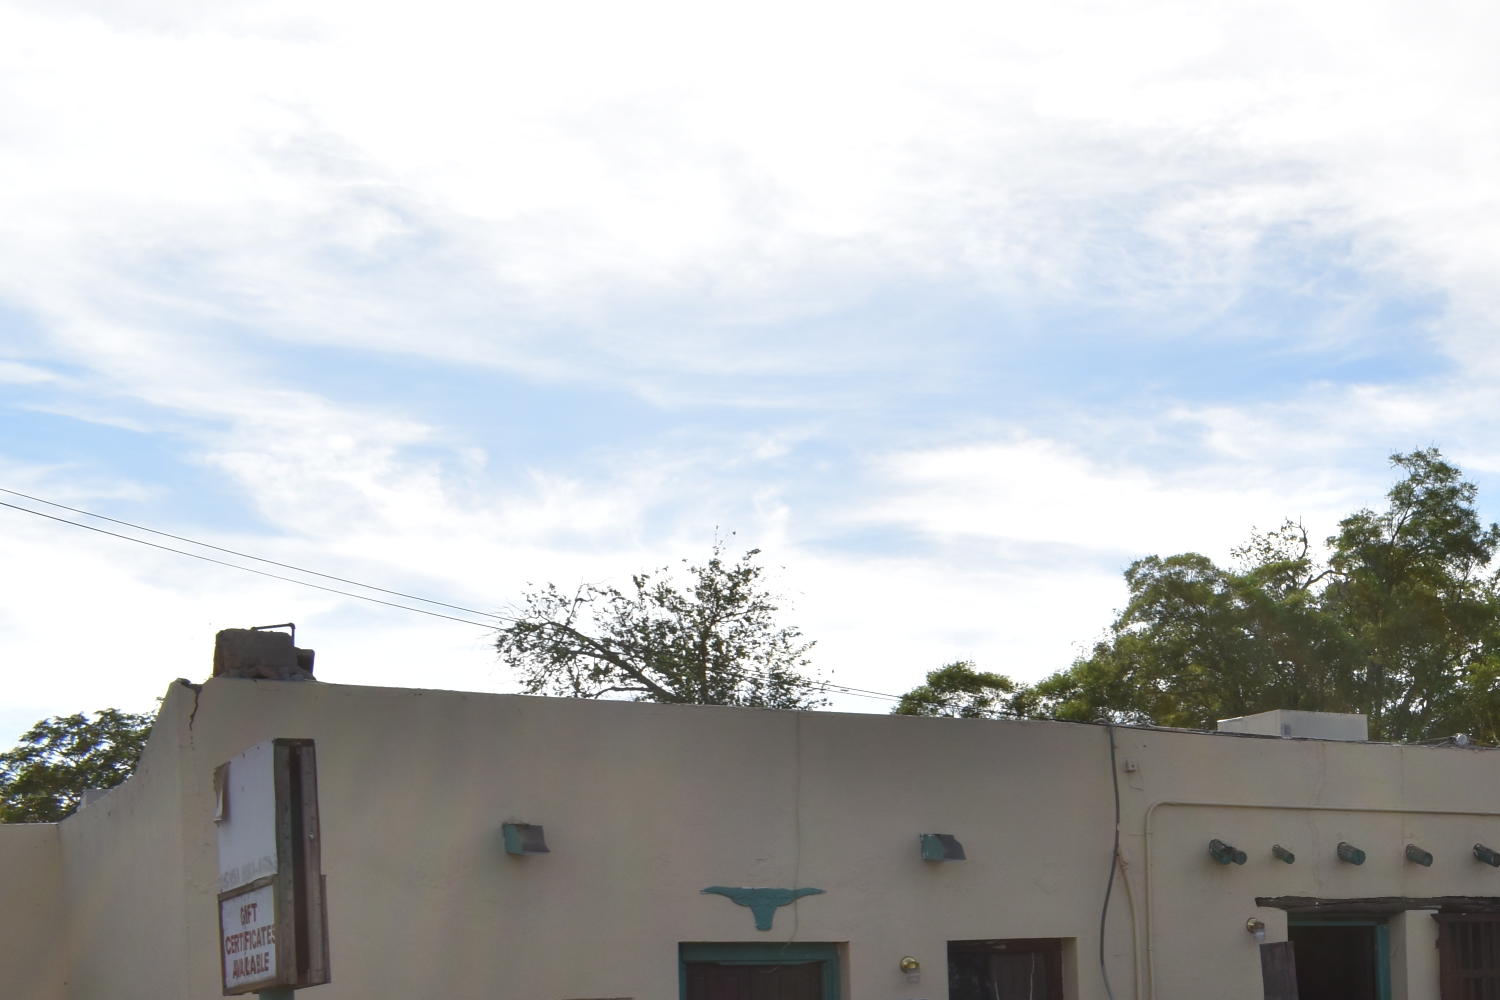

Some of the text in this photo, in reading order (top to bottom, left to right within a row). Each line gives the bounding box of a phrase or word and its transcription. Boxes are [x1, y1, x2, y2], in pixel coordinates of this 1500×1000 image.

[239, 903, 258, 925] GIFT
[224, 925, 276, 955] CERTIFICATES
[232, 952, 270, 979] AVAILABLE
